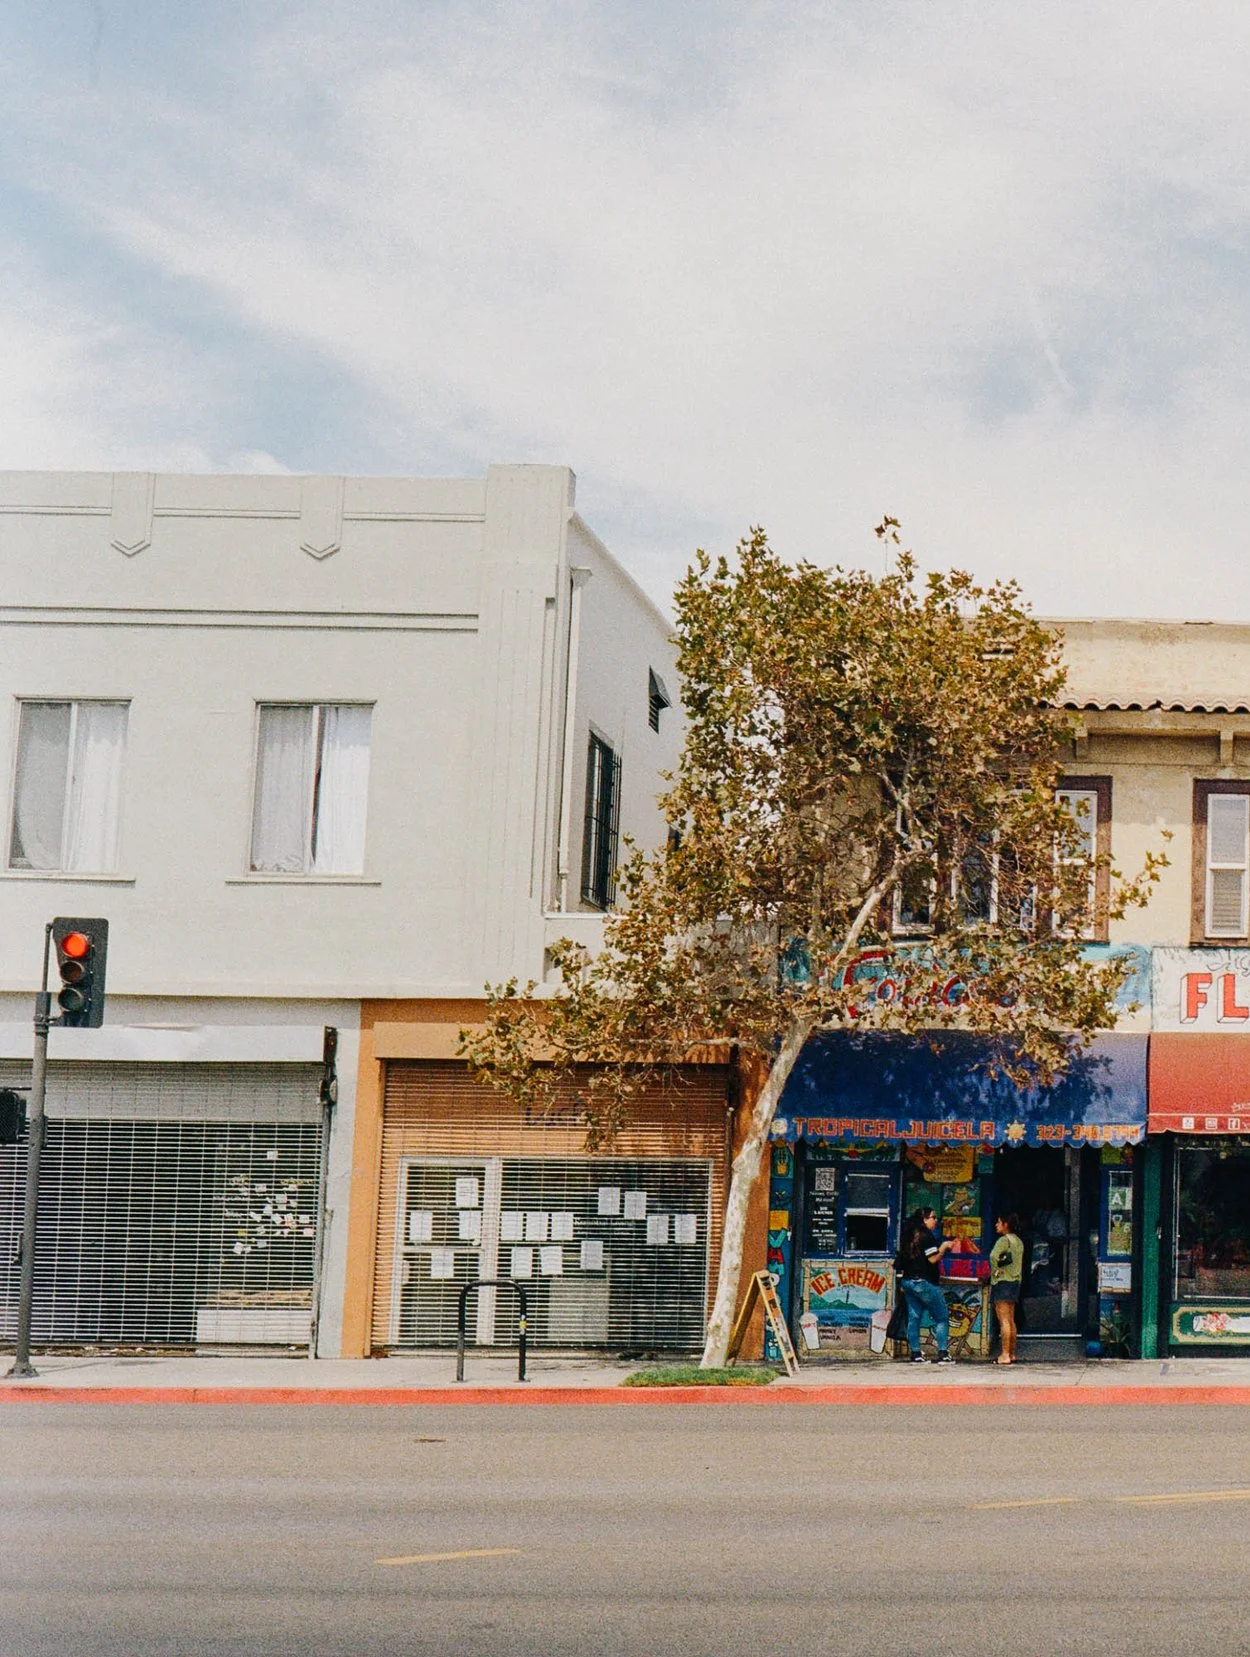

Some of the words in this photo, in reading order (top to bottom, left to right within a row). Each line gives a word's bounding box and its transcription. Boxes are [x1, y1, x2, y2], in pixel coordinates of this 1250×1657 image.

[1111, 1192, 1123, 1206] A
[810, 1271, 836, 1295] ICE
[837, 1266, 887, 1294] CREAM
